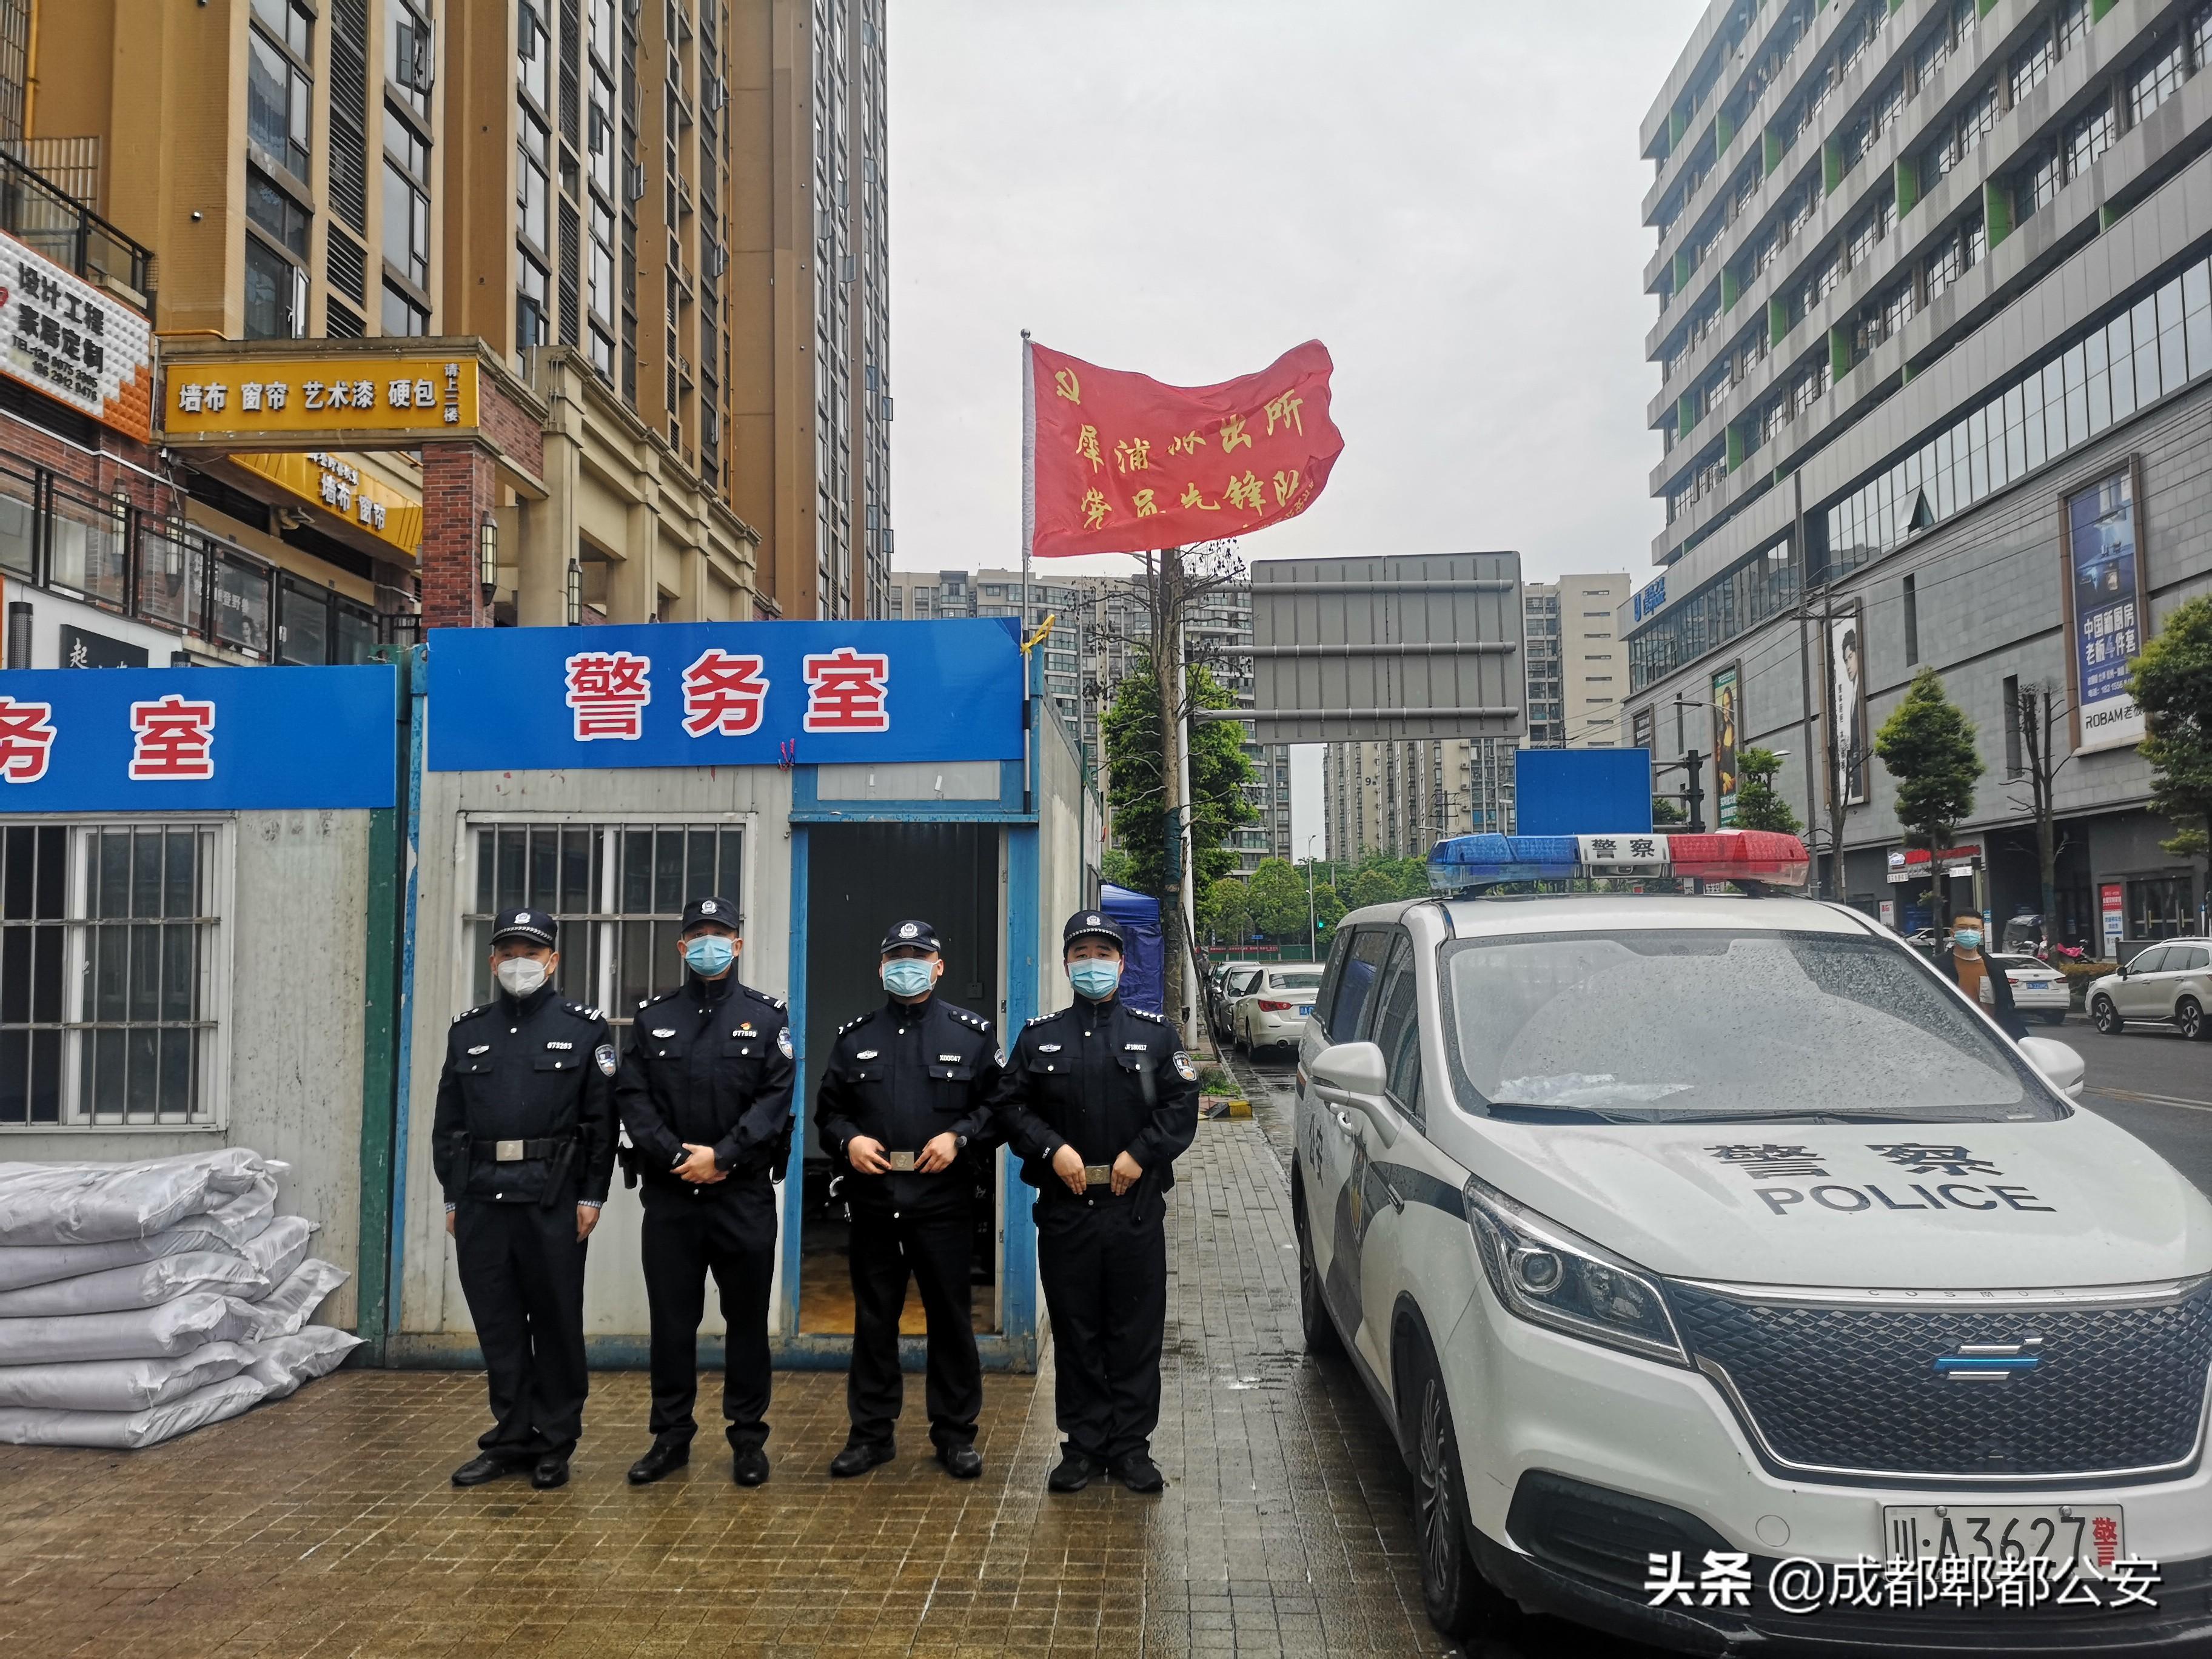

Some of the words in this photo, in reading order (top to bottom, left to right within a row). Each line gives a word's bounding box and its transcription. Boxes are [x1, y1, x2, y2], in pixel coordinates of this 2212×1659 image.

[19, 261, 104, 337] 设计工程
[18, 303, 103, 374] 家居定制
[179, 382, 227, 412] 墙布
[241, 381, 288, 411] 窗帘
[303, 380, 375, 409] 艺术漆
[388, 378, 437, 408] 硬包
[444, 364, 460, 423] 请上二楼
[321, 472, 352, 512] 墙布
[358, 494, 386, 531] 窗帘
[2083, 603, 2134, 640] 中国新厨房
[2086, 628, 2136, 666] 老板4件套
[566, 648, 890, 740] 警务室
[0, 694, 215, 783] 务室
[1591, 839, 1655, 859] 警察
[1703, 1142, 2005, 1179] 警察
[1754, 1184, 2057, 1215] POLICE
[1867, 1289, 2065, 1298] COSMOS
